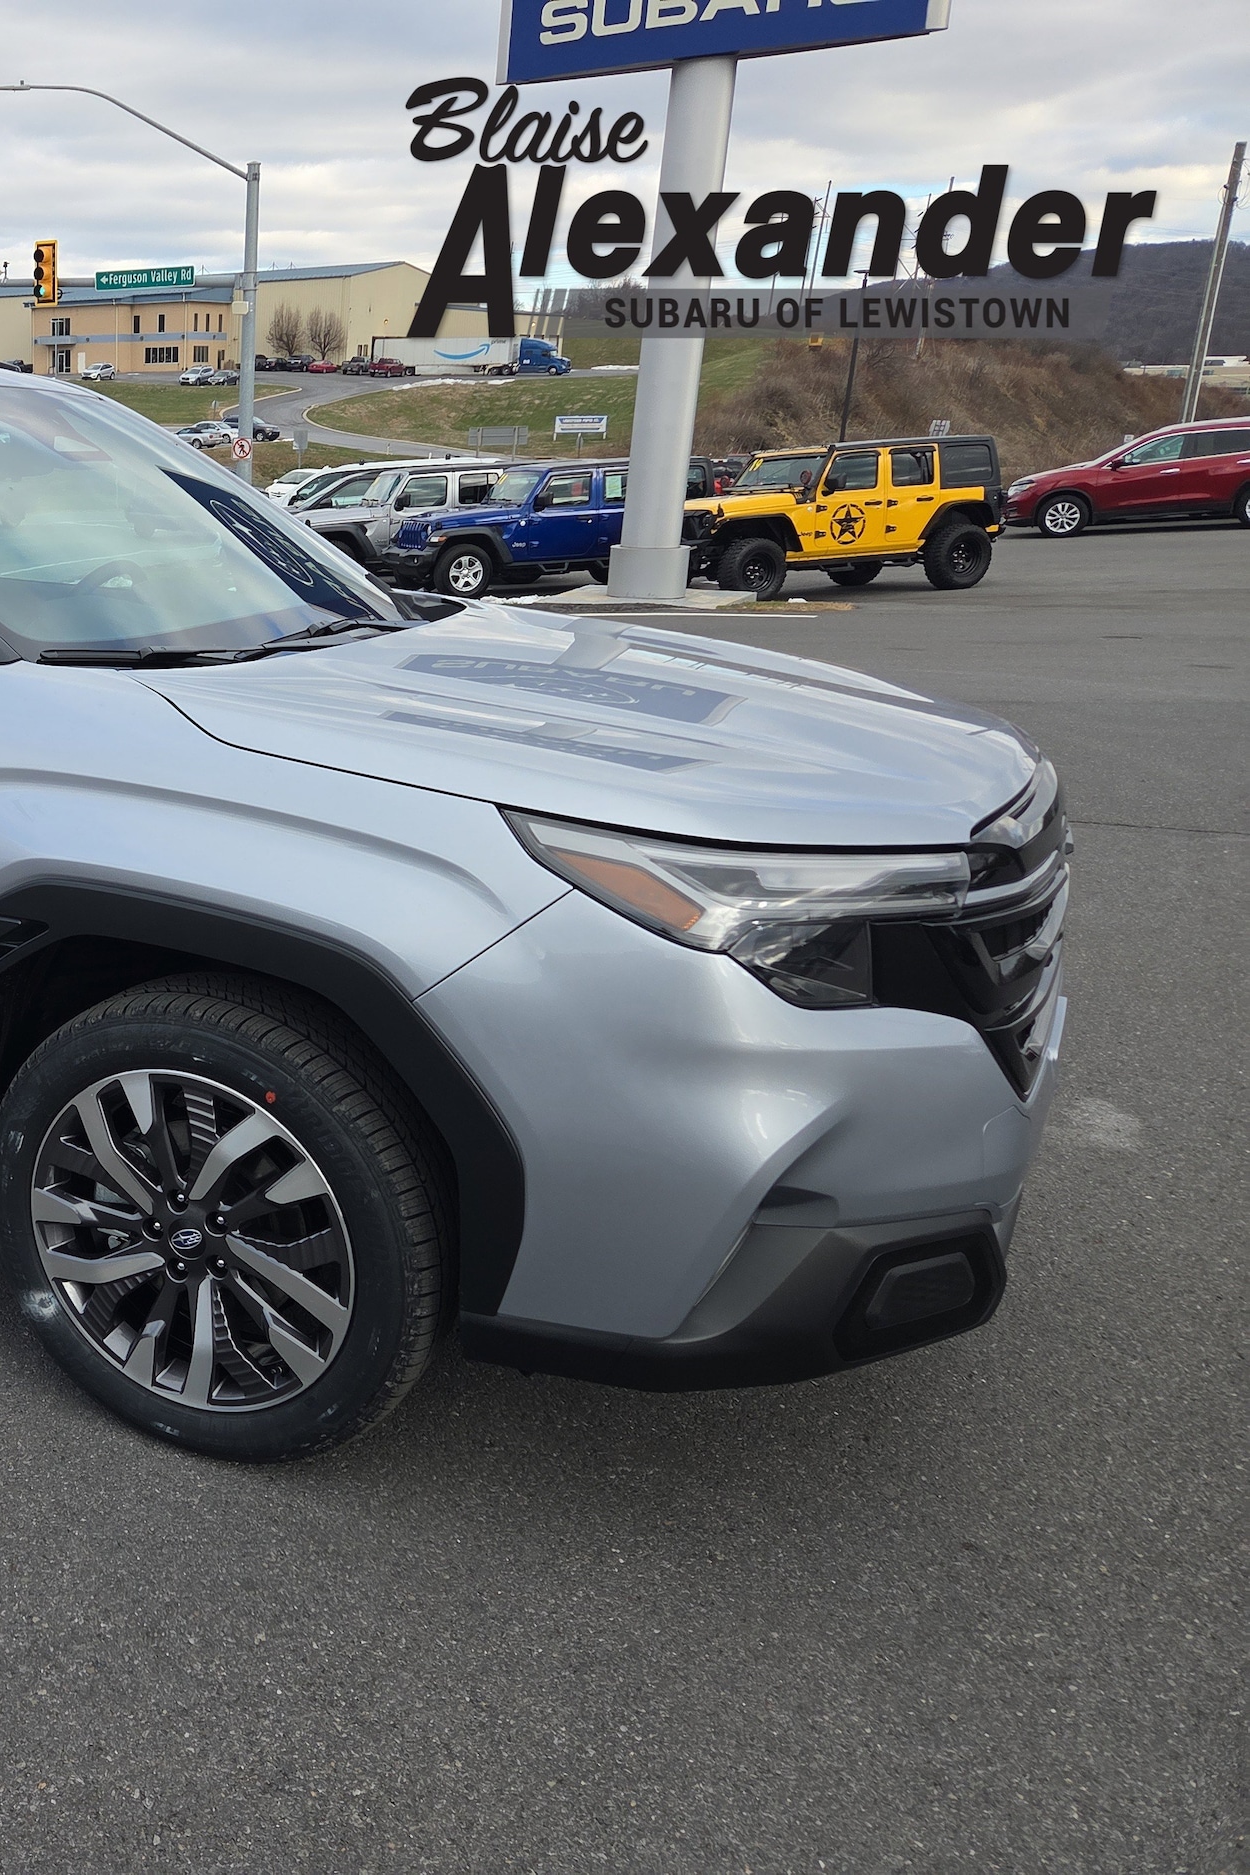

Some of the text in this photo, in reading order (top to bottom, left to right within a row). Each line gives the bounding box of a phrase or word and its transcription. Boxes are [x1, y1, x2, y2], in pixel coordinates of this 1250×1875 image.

[539, 0, 880, 45] SUB
[109, 268, 191, 287] Ferguson Valley Rd
